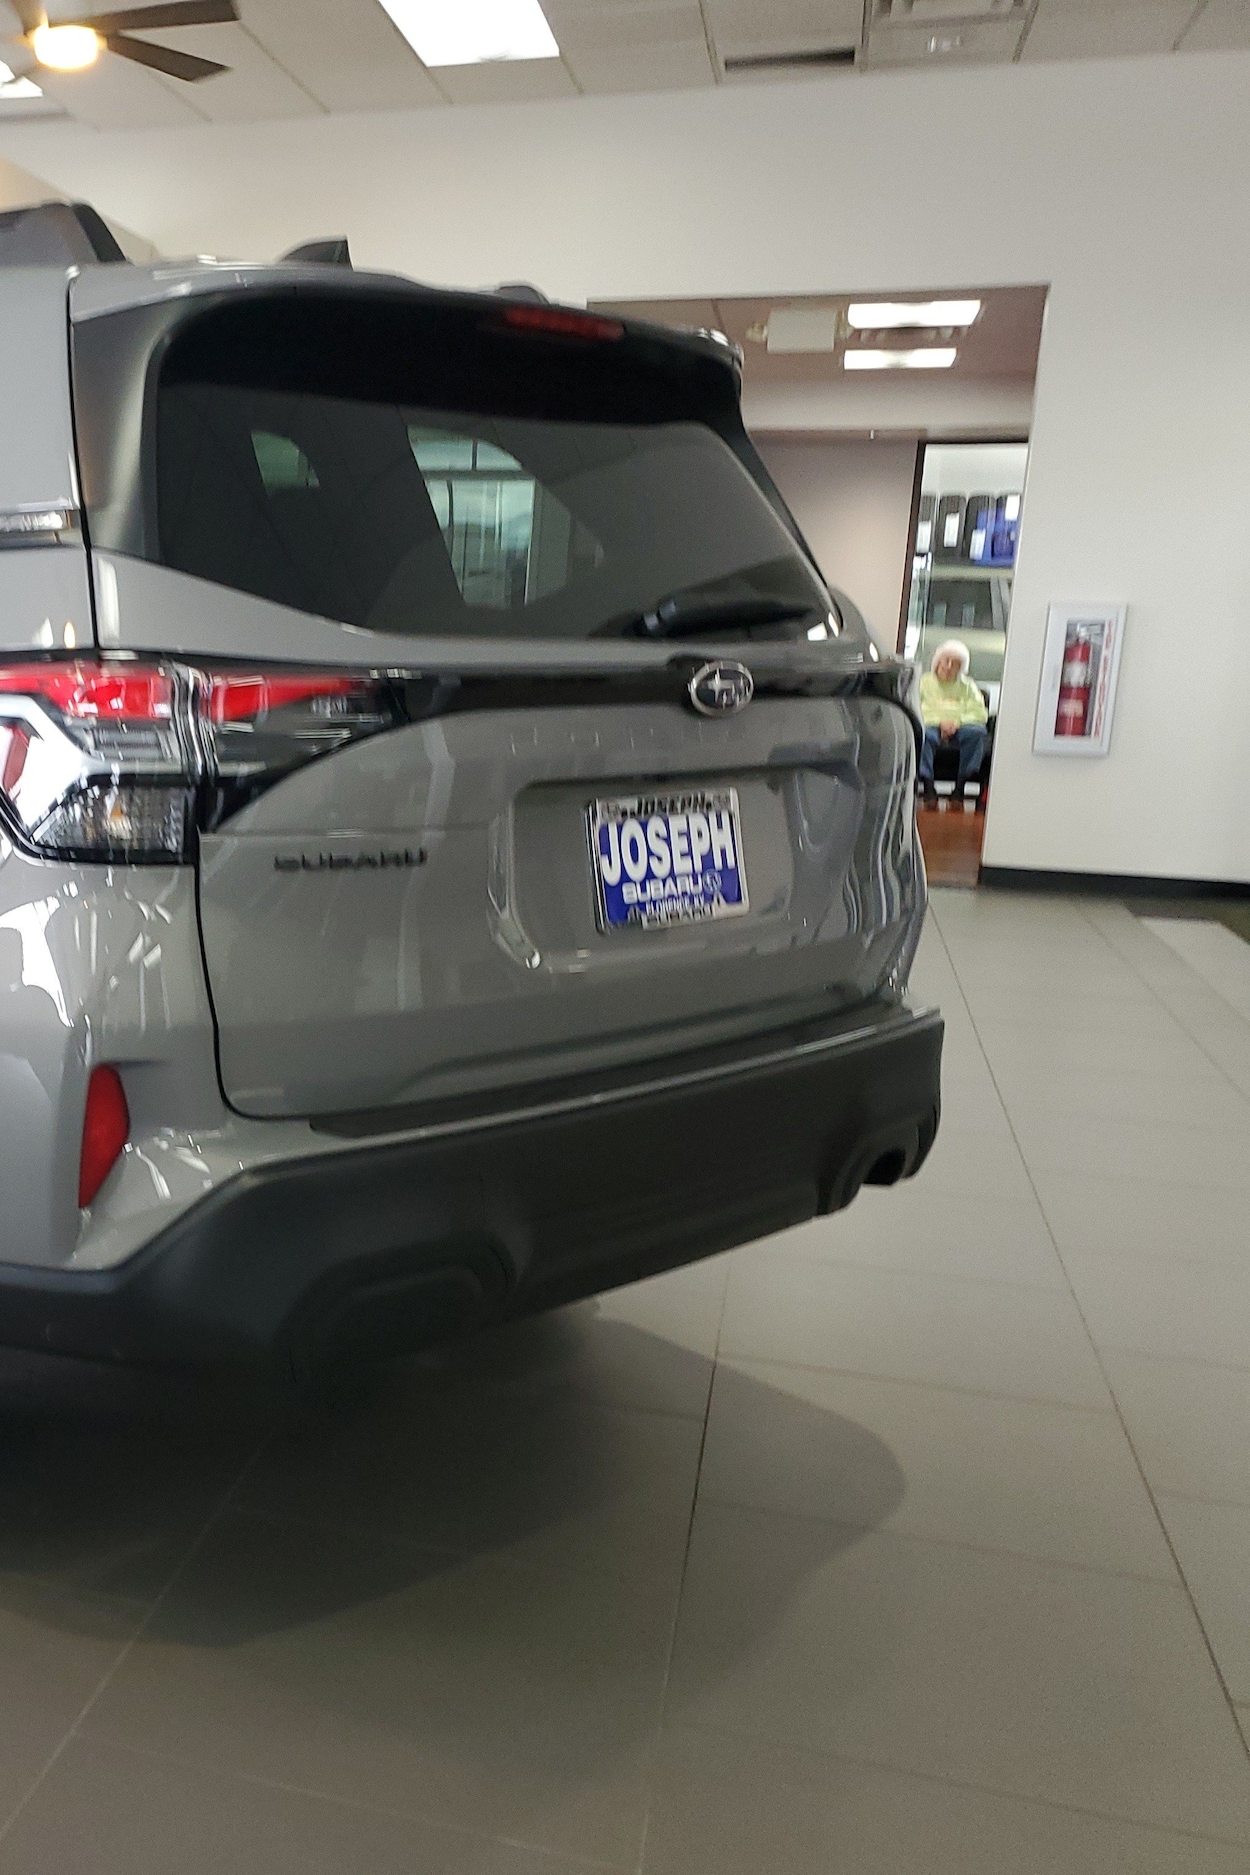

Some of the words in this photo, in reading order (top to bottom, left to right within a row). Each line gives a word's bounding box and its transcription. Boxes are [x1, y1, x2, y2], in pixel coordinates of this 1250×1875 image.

[274, 847, 429, 872] SUBARU
[600, 810, 736, 887] JOSEPH
[622, 873, 703, 905] SUBARU
